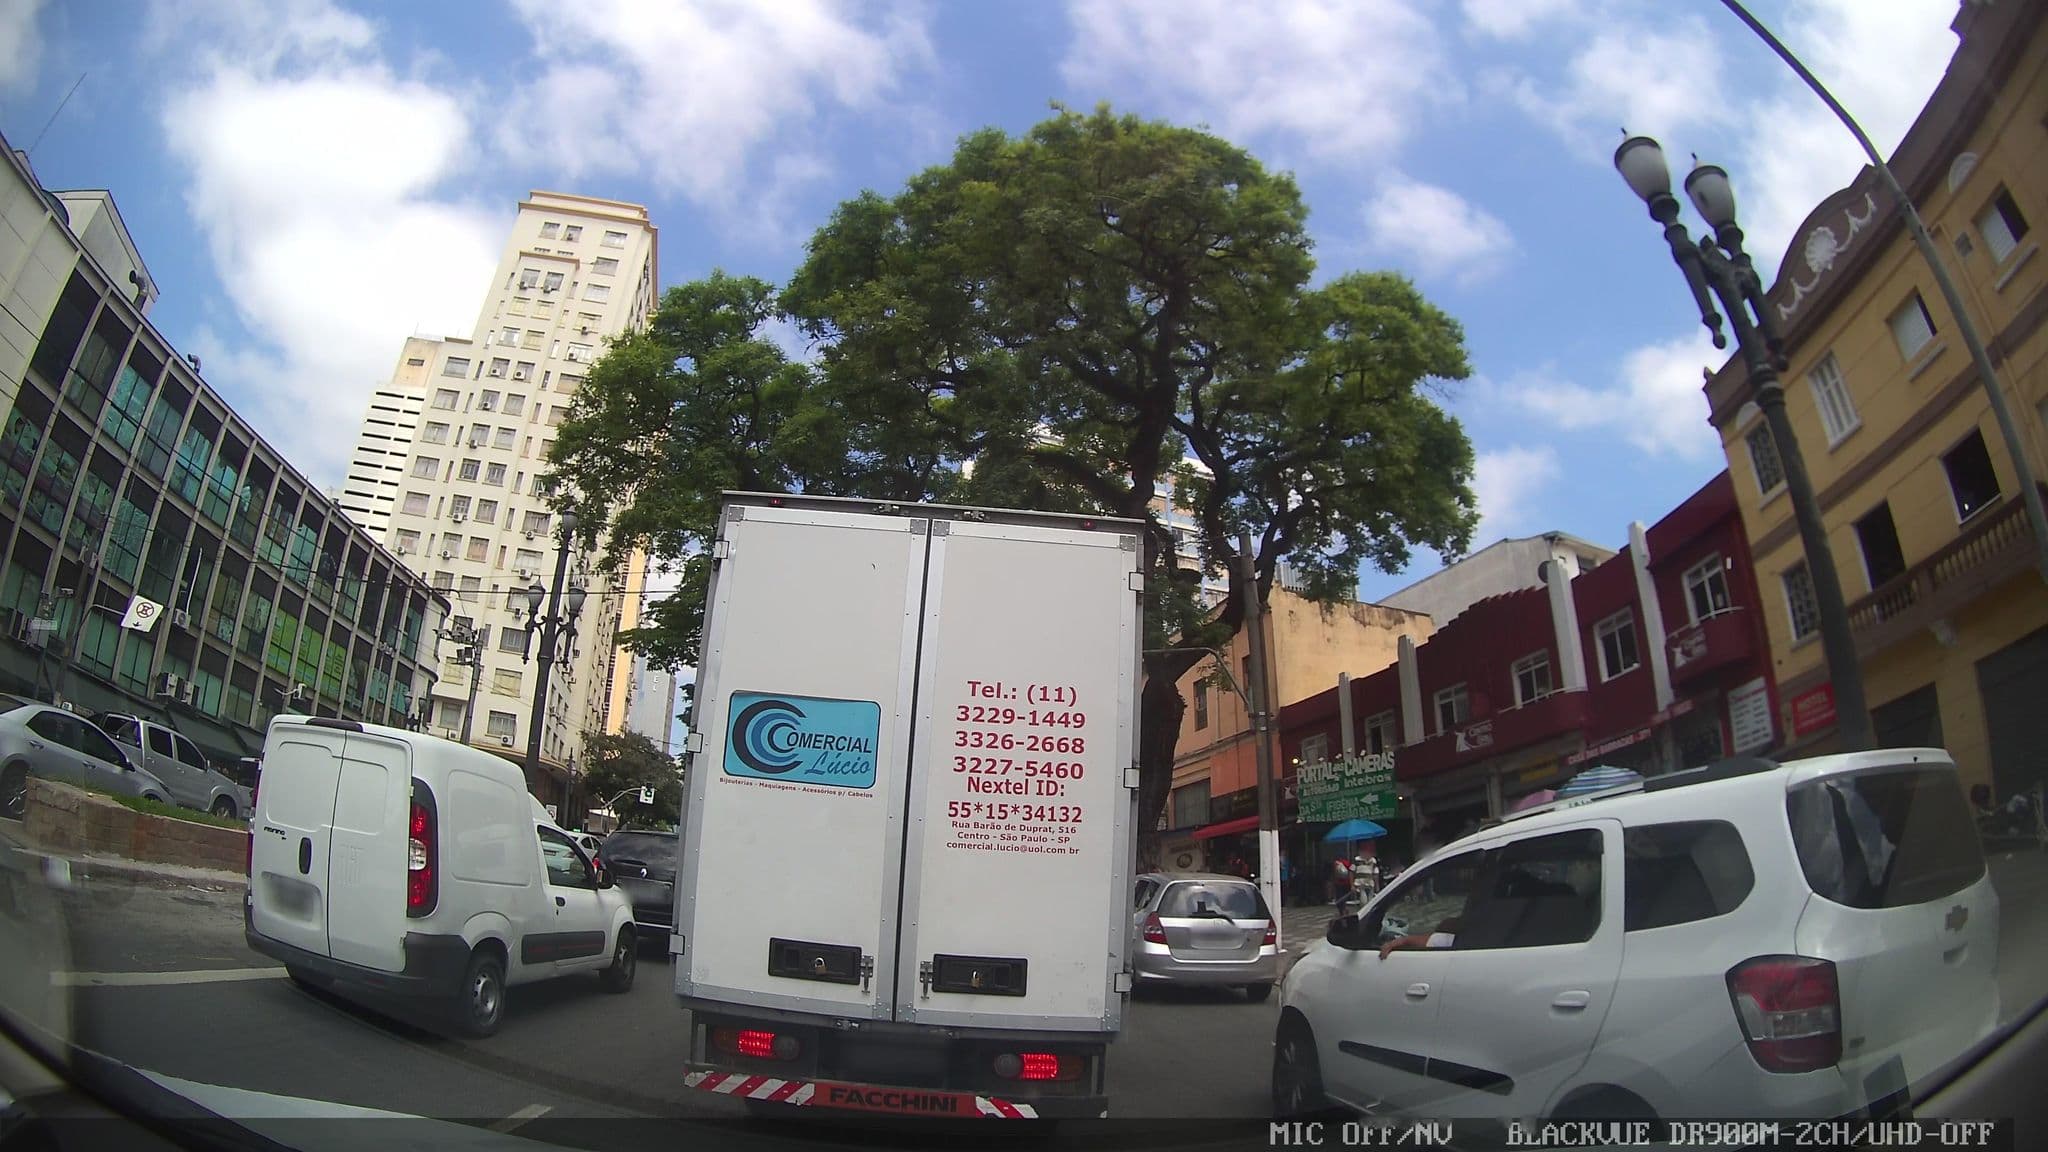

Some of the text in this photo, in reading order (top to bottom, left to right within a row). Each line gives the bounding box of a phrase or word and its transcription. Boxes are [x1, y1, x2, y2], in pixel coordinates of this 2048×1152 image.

[967, 680, 1077, 708] Tel.: (11)
[956, 705, 1086, 728] 3229-1449
[955, 730, 1085, 754] 3326-2668
[804, 750, 871, 776] Lúcio
[953, 756, 1084, 779] 3227-5460
[1297, 763, 1333, 784] PORTAL
[719, 777, 753, 786] Bijouterias
[759, 782, 796, 791] Maquiagens
[802, 786, 836, 796] Acessórios
[847, 790, 873, 799] Cabelos
[967, 776, 1064, 797] Nextel ID:
[952, 820, 1077, 835] Rua Barão de Duprat, 516
[957, 832, 990, 840] Centro
[1000, 833, 1018, 841] São
[1021, 835, 1048, 843] Paulo
[1057, 836, 1071, 844] SP
[829, 1087, 958, 1113] FACCHINI
